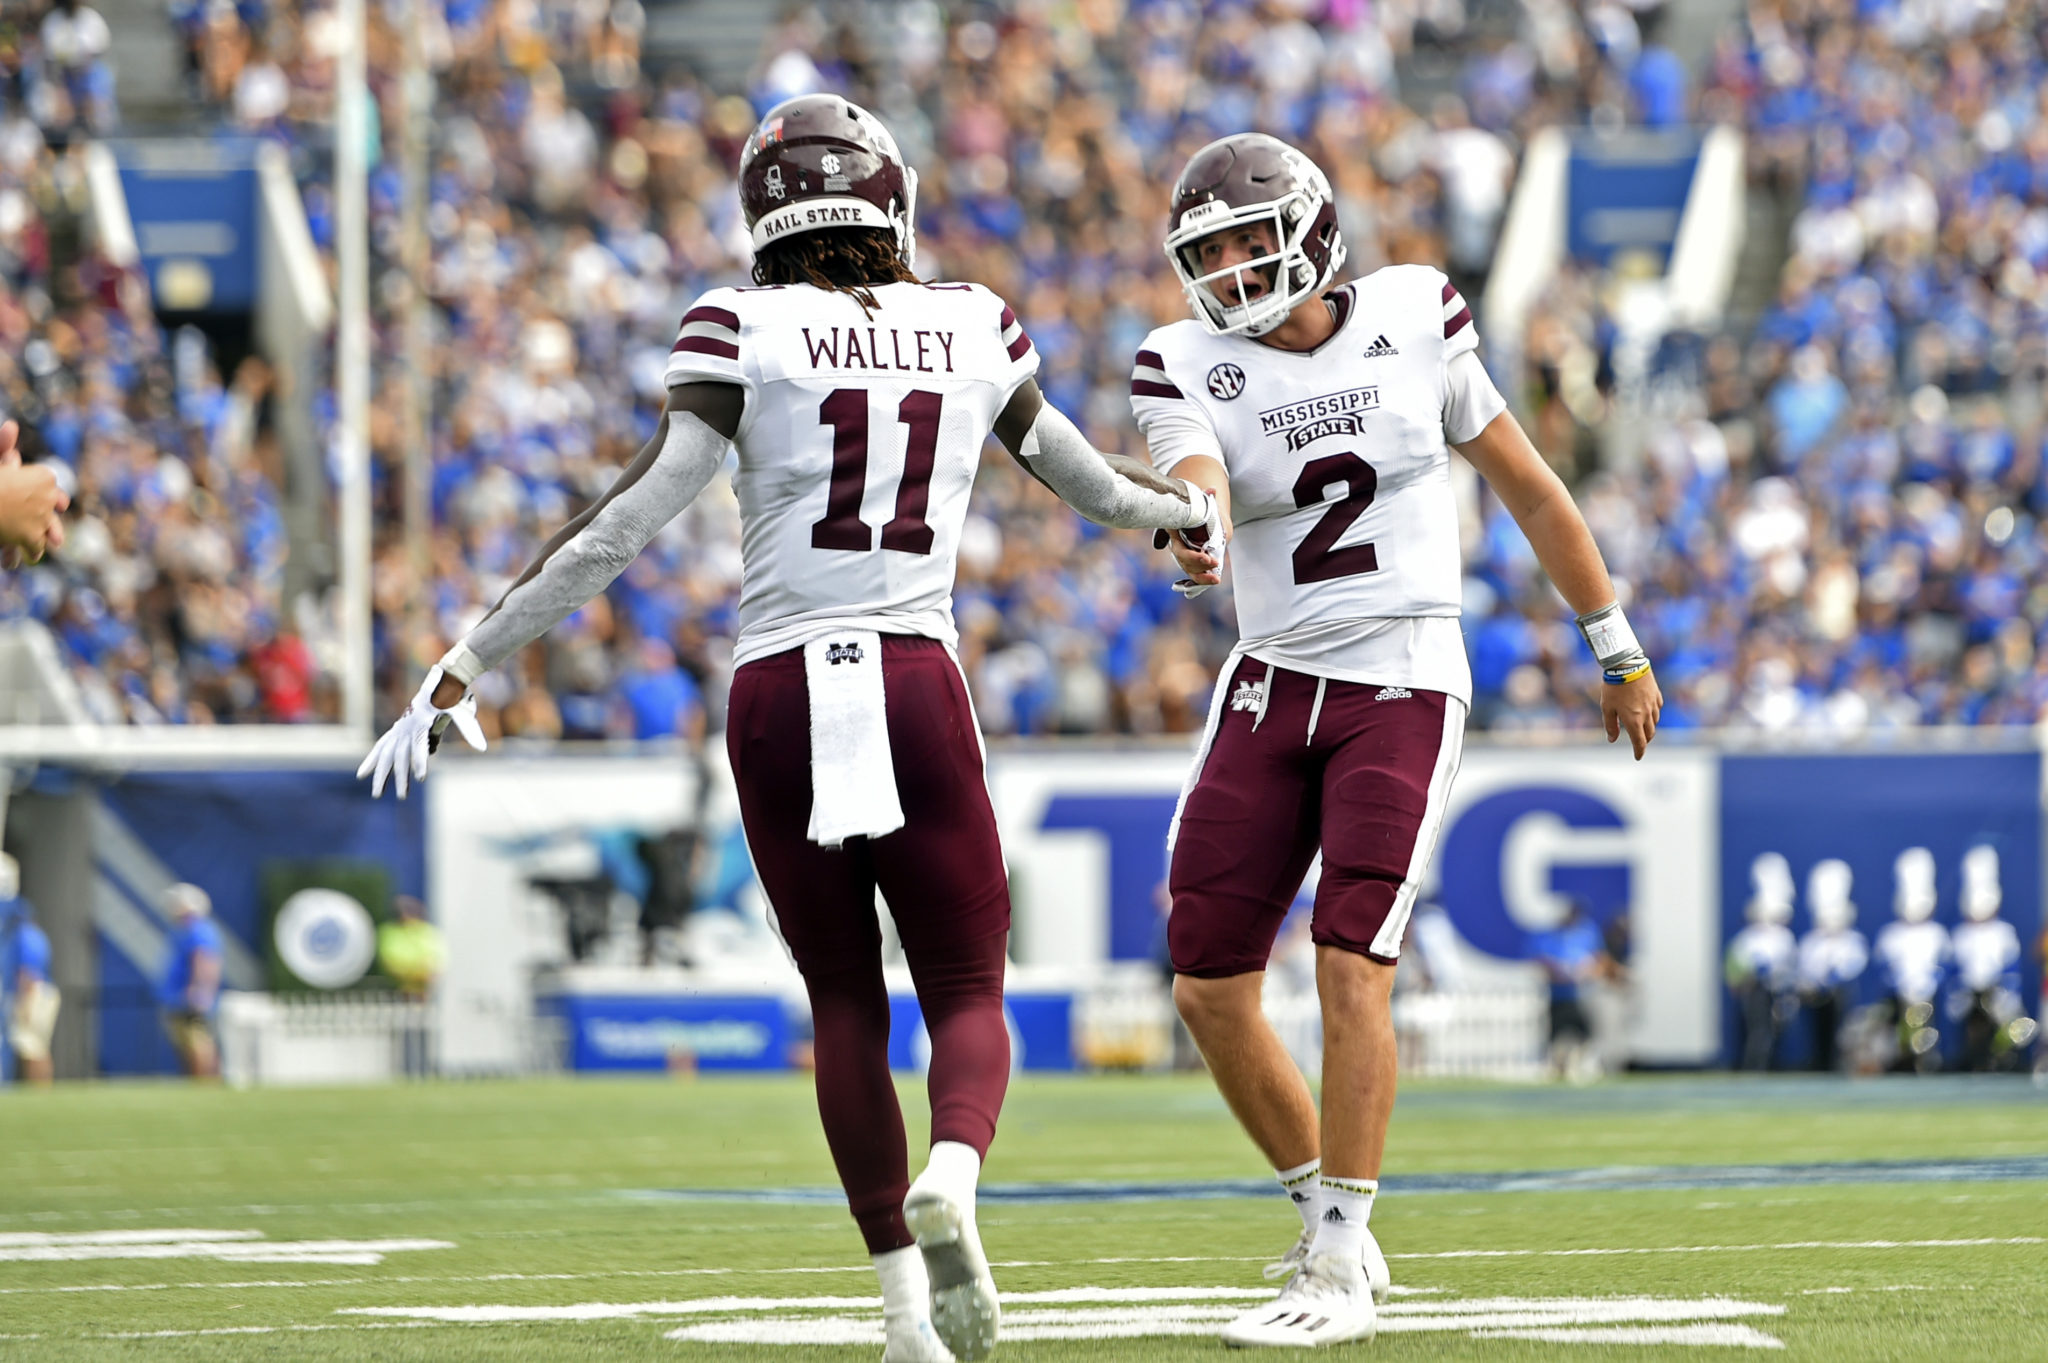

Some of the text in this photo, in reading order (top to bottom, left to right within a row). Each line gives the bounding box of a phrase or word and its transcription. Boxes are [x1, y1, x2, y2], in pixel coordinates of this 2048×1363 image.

[764, 207, 862, 238] HAIL STATE
[802, 327, 953, 373] WALLEY
[1363, 348, 1399, 359] adidas
[1207, 363, 1246, 400] SEC
[1260, 390, 1380, 432] MISSISSIPPI
[1297, 420, 1351, 446] STATE
[811, 388, 943, 555] 11
[1292, 451, 1379, 586] 2
[1375, 687, 1413, 701] adidas
